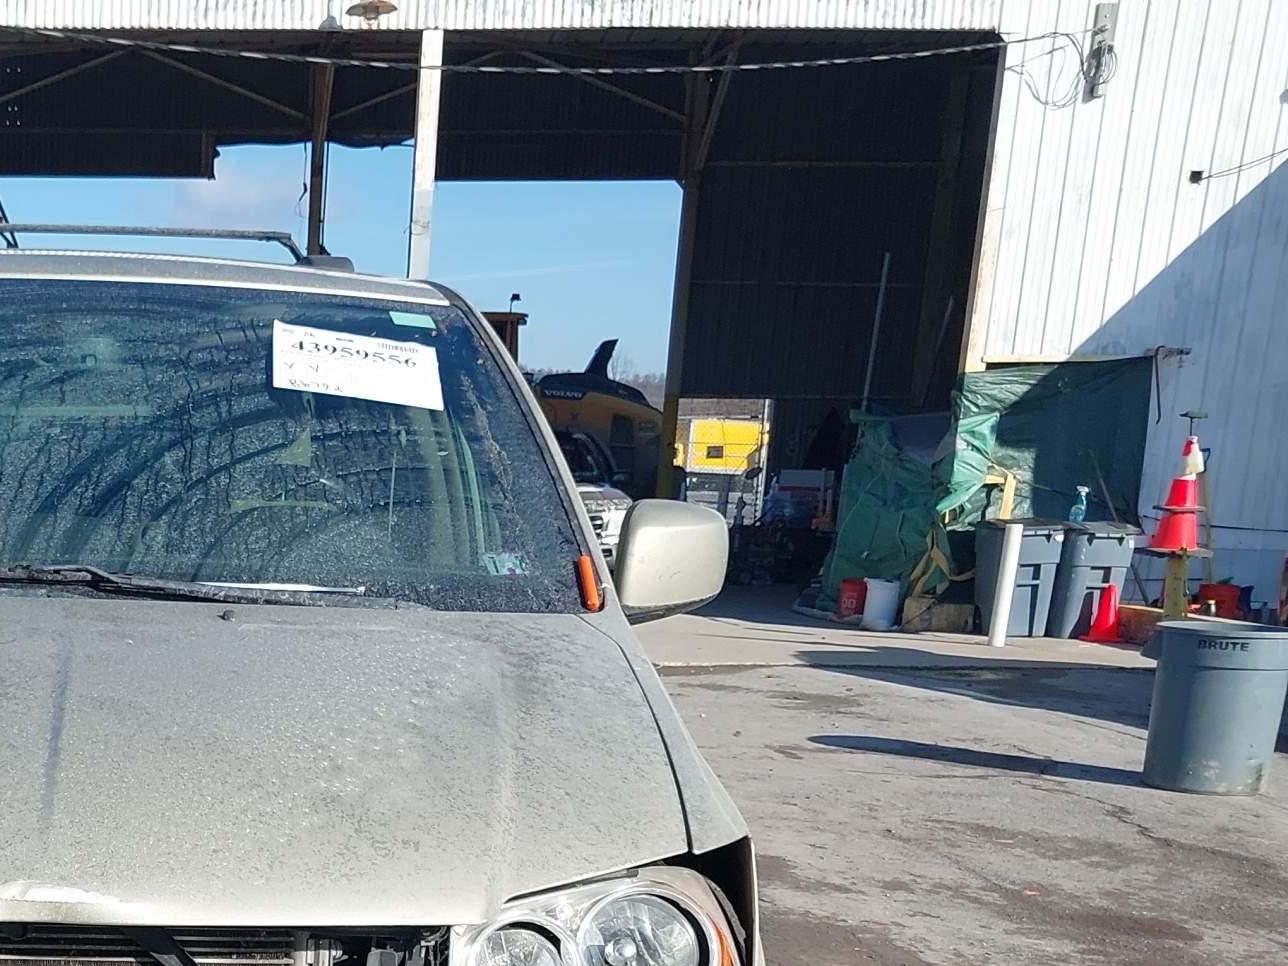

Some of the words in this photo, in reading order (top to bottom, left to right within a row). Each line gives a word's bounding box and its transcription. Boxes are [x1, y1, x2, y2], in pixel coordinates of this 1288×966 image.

[291, 340, 417, 368] 43959556
[544, 389, 583, 399] VOLVO
[1197, 639, 1250, 653] BRUTE
